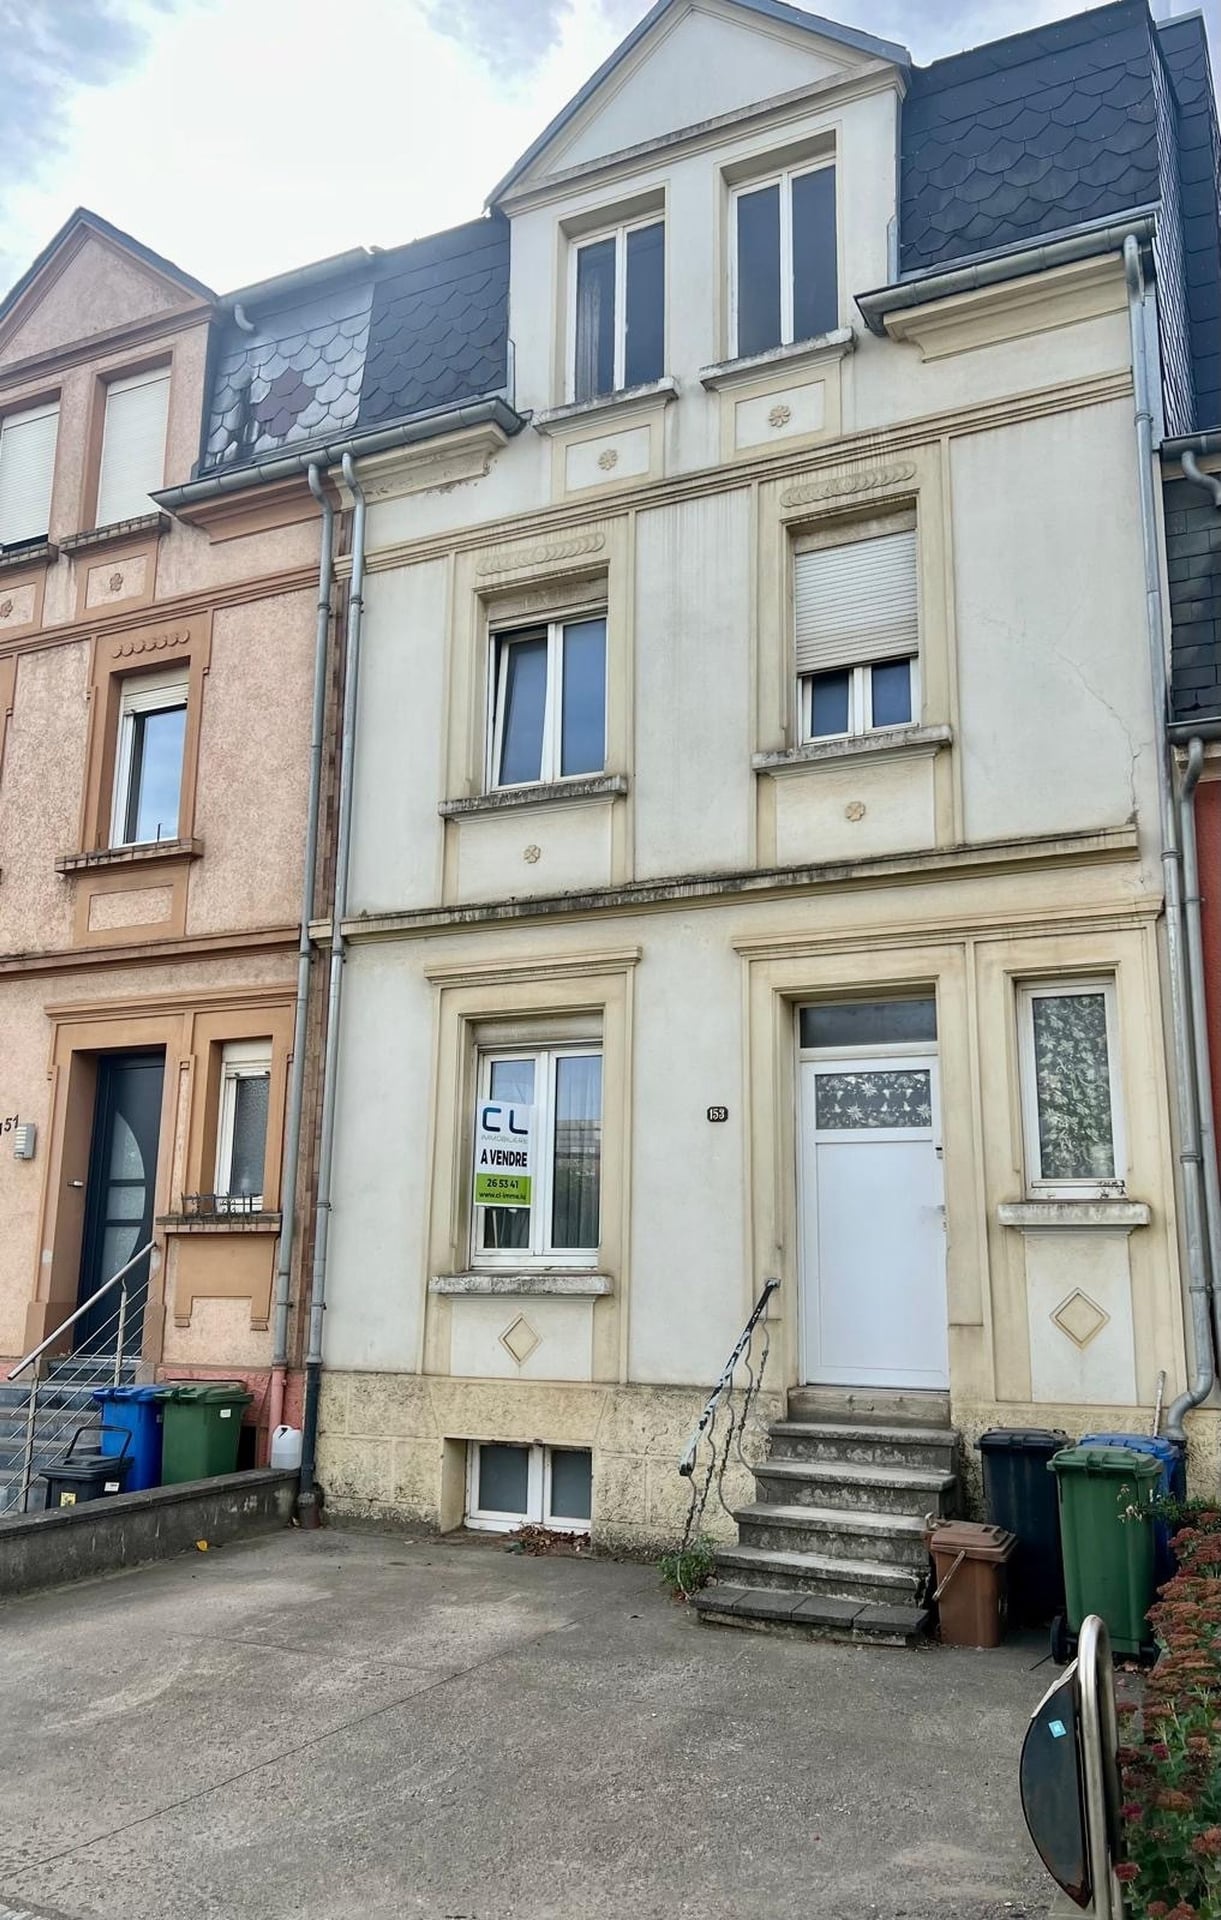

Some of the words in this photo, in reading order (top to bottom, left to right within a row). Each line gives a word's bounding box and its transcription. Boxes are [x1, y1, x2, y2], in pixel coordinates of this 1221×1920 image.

[482, 1107, 528, 1135] CL
[709, 1108, 725, 1120] 153
[480, 1149, 488, 1165] A
[490, 1150, 528, 1167] VENDRE
[487, 1178, 498, 1188] 26
[499, 1179, 508, 1189] 53
[510, 1180, 519, 1189] 41
